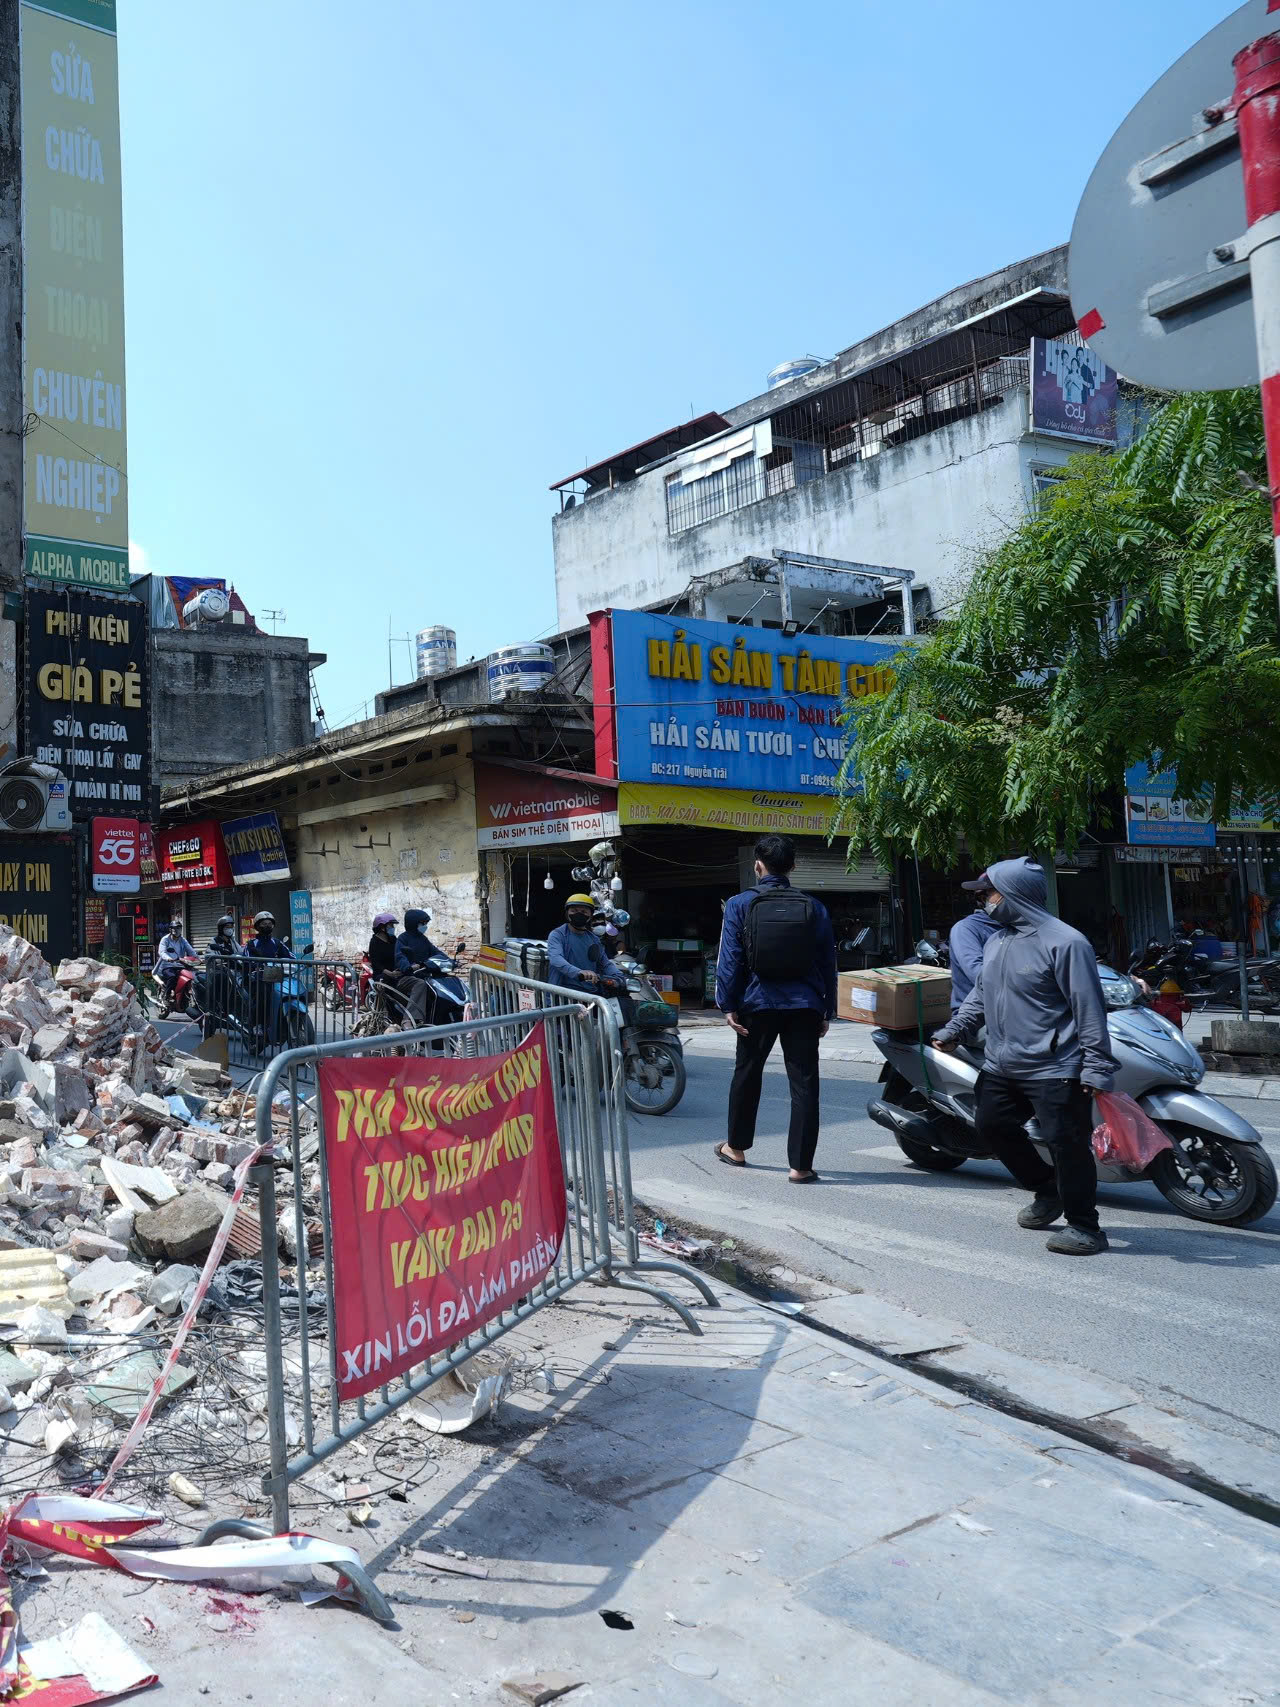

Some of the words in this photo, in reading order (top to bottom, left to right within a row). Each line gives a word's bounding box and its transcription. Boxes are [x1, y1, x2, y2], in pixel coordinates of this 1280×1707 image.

[50, 40, 95, 104] SỬA
[45, 125, 105, 184] CHỮA
[33, 367, 121, 431] CHUYÊN
[35, 453, 119, 524] NGHIỆP
[31, 551, 75, 579] ALPHA
[80, 556, 126, 586] MOBILE
[90, 613, 129, 646] KIỆN
[37, 657, 93, 703] GIÁ
[648, 630, 702, 681] HẢI
[710, 637, 772, 689] SẢN
[779, 650, 841, 697] TÂM
[53, 714, 84, 738] SỬA
[89, 721, 128, 741] CHỮA
[749, 700, 786, 721] BUÔN
[798, 704, 826, 726] BÁN
[650, 716, 688, 747] HẢI
[696, 720, 740, 752] SẢN
[746, 730, 792, 756] TƯƠI
[65, 748, 94, 770] THOẠI
[96, 745, 114, 769] LẤY
[117, 753, 142, 770] GAY
[651, 762, 665, 775] ĐC:
[666, 763, 680, 776] 217
[684, 764, 712, 780] Nguyễn
[712, 766, 728, 780] Trãi
[75, 778, 107, 799] MÀN
[110, 780, 141, 800] HNH
[513, 790, 600, 817] vietnamobile
[104, 829, 135, 838] viettel
[169, 837, 200, 854] CHEF&GO
[492, 829, 510, 841] BÁN
[512, 828, 526, 837] SIM
[528, 822, 545, 836] THẺ
[547, 820, 569, 836] ĐIỆN
[571, 817, 601, 832] THOẠI
[98, 838, 135, 866] 5G
[261, 849, 283, 863] Mobile
[25, 862, 51, 892] PIN
[294, 896, 308, 909] SỬA
[12, 908, 48, 943] KÍNH
[335, 1077, 396, 1142] PHÁ
[400, 1074, 442, 1131] DỠ
[432, 1134, 486, 1196] HIỆN
[458, 1205, 497, 1262] ĐAI
[342, 1330, 392, 1384] XIN
[397, 1299, 433, 1356] LỖI
[468, 1267, 507, 1315] LÀM
